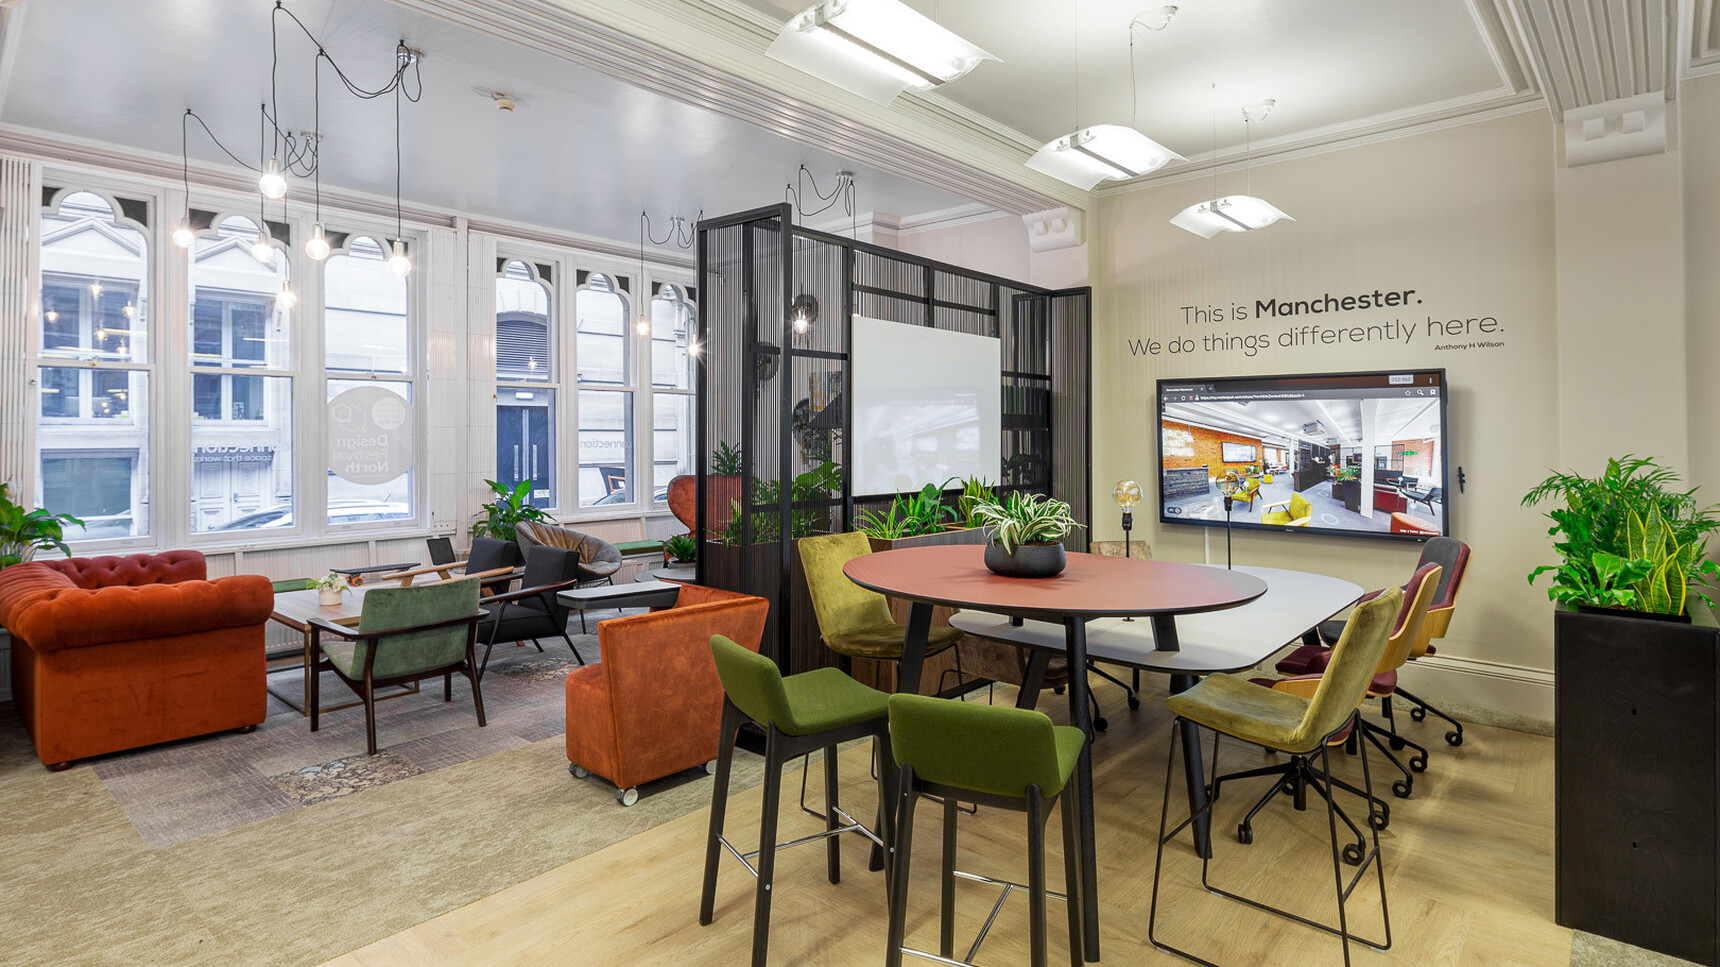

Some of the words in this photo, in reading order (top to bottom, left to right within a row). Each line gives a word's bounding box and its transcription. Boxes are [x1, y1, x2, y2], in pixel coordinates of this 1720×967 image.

[1180, 305, 1224, 324] This
[1231, 303, 1248, 320] is
[1255, 289, 1423, 319] Manchester.
[1128, 337, 1161, 356] We
[1168, 336, 1195, 354] do
[1202, 332, 1270, 357] things
[1278, 318, 1417, 347] differently
[1427, 316, 1505, 337] here.
[1434, 343, 1468, 351] Anthony
